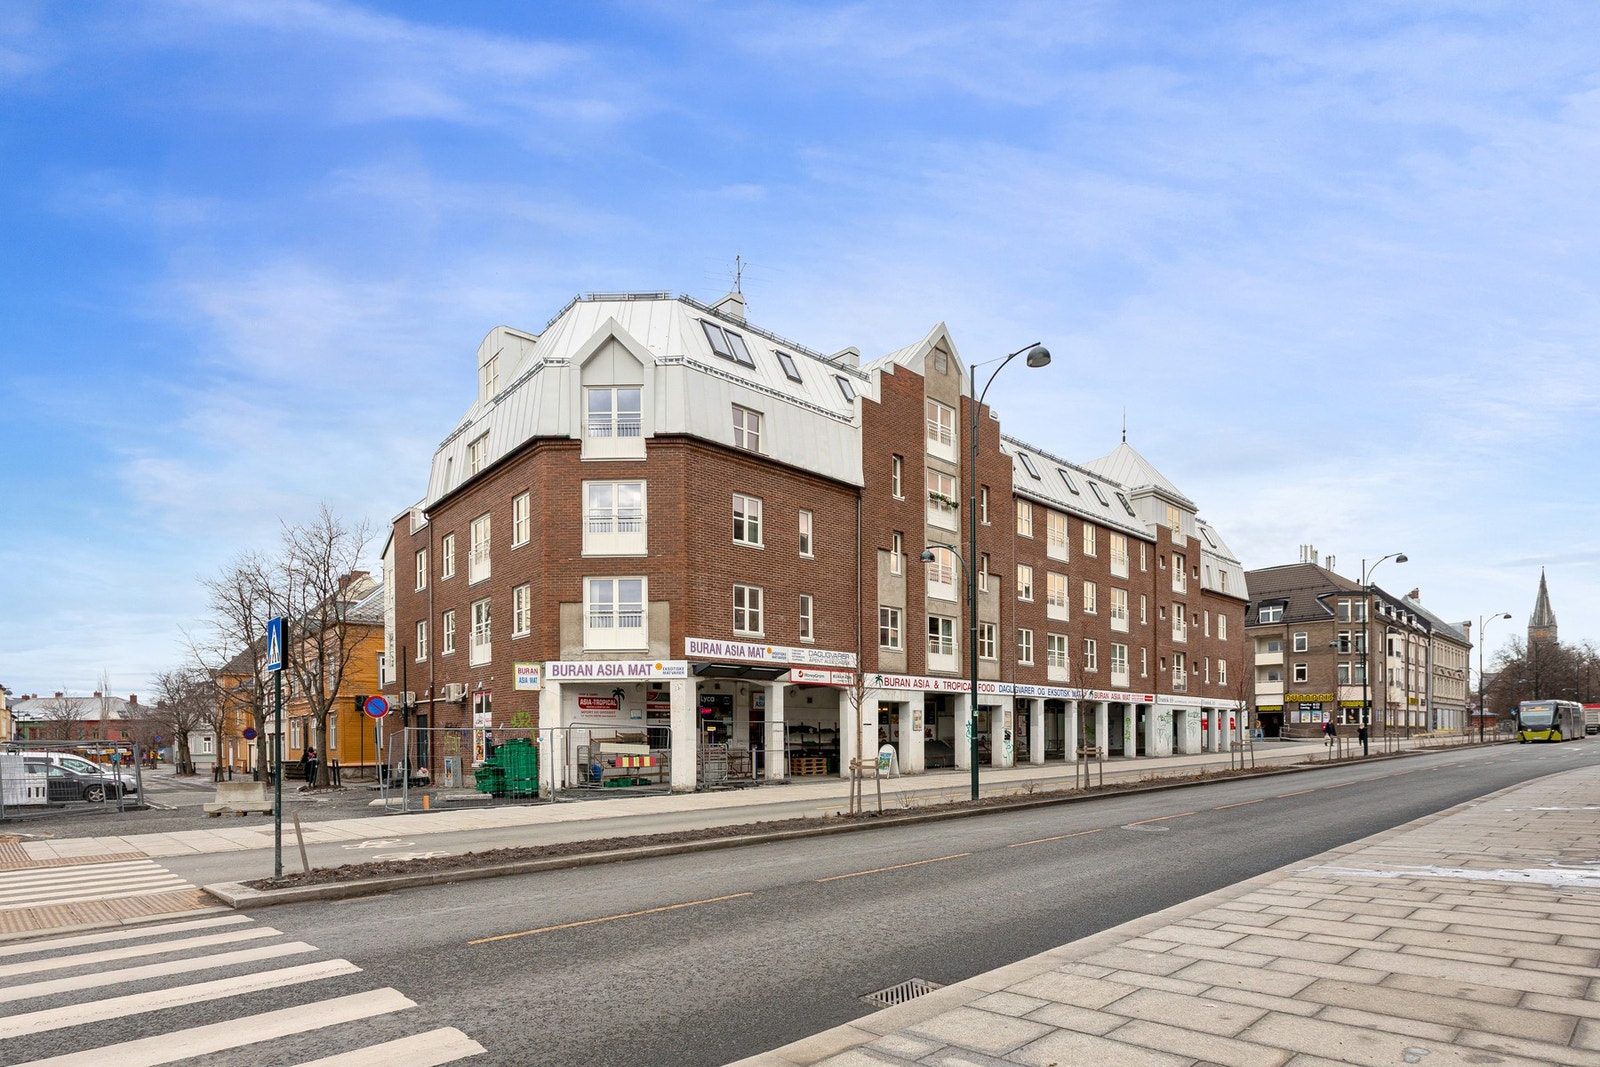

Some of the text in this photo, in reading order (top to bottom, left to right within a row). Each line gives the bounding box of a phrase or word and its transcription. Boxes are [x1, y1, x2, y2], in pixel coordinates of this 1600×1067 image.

[690, 641, 765, 659] BURAN ASIA MAT
[517, 667, 539, 675] BURAN
[552, 663, 653, 677] BURAN ASIA MAT
[884, 677, 911, 687] BURAN
[913, 679, 930, 689] ASIA
[933, 680, 939, 689] &
[942, 681, 972, 691] TROPICA
[978, 683, 995, 693] FOOD
[1037, 687, 1046, 695] OG
[1047, 689, 1071, 697] EKSOTISK
[580, 698, 617, 706] ASIA-TROPICAL
[1284, 693, 1334, 702] BUNNPRIS
